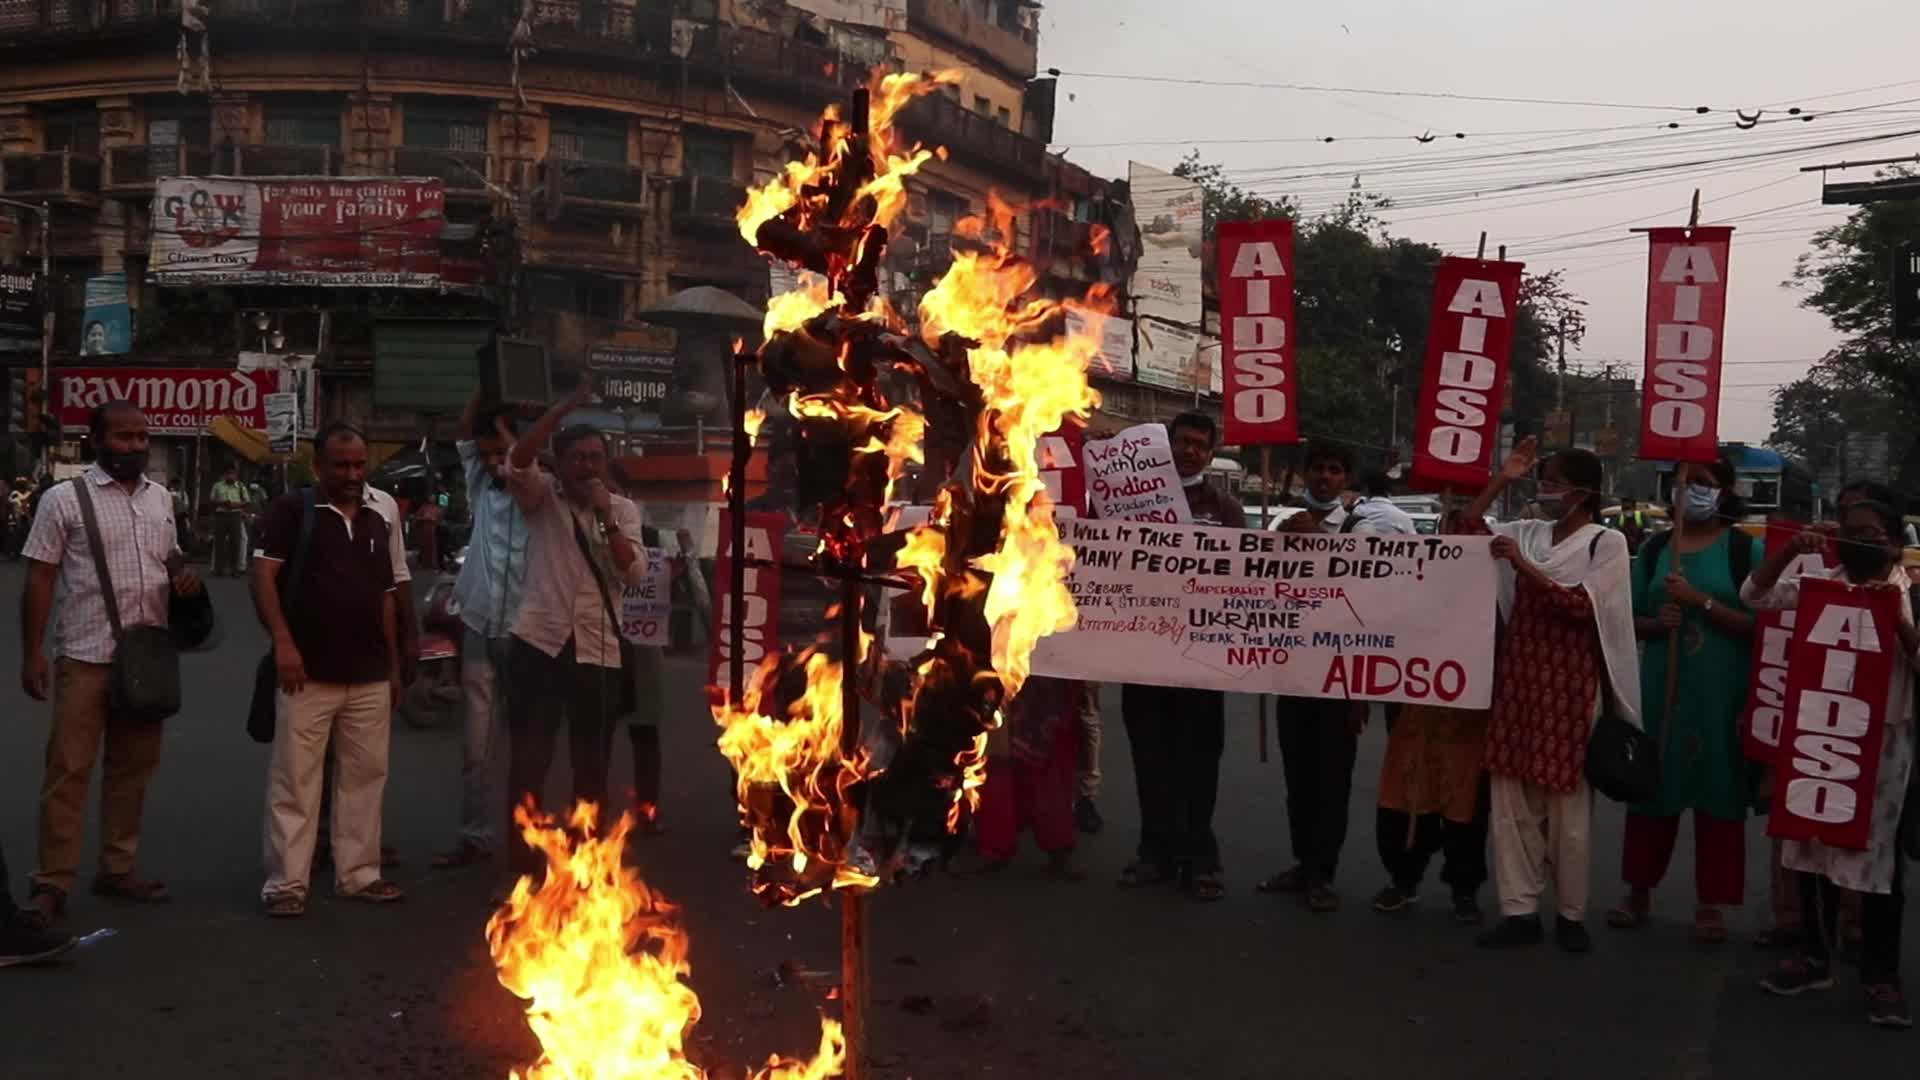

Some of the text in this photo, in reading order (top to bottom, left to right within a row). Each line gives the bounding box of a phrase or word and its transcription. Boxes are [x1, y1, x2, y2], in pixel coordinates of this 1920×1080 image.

[280, 200, 408, 223] your family
[1230, 241, 1286, 424] AIDSO
[1649, 245, 1719, 438] AIDSO
[1427, 278, 1506, 464] AIDSO
[605, 376, 666, 403] imagine
[145, 413, 168, 426] NCY
[1089, 437, 1151, 462] We Are
[1121, 447, 1170, 472] You
[1092, 476, 1166, 500] Indian
[1073, 523, 1110, 541] WILL
[1116, 526, 1132, 542] IT
[1138, 527, 1184, 548] TAKE
[1193, 532, 1232, 552] TILL
[1239, 533, 1275, 553] BE
[1283, 535, 1357, 553] KNOWS
[1366, 537, 1419, 558] THAT
[1424, 538, 1464, 560] TOO
[1073, 545, 1122, 570] MANY
[1131, 549, 1232, 577] PEOPLE
[1244, 557, 1315, 579] HAVE
[1275, 582, 1346, 600] RUSSIA
[1223, 598, 1276, 610] HANDS
[1189, 608, 1300, 633] UKRAINE
[1190, 632, 1395, 650] BREAK THE WAR MACHINE
[1227, 648, 1288, 669] NATO
[1321, 655, 1467, 702] AIDSO
[1785, 603, 1882, 824] AIDSO
